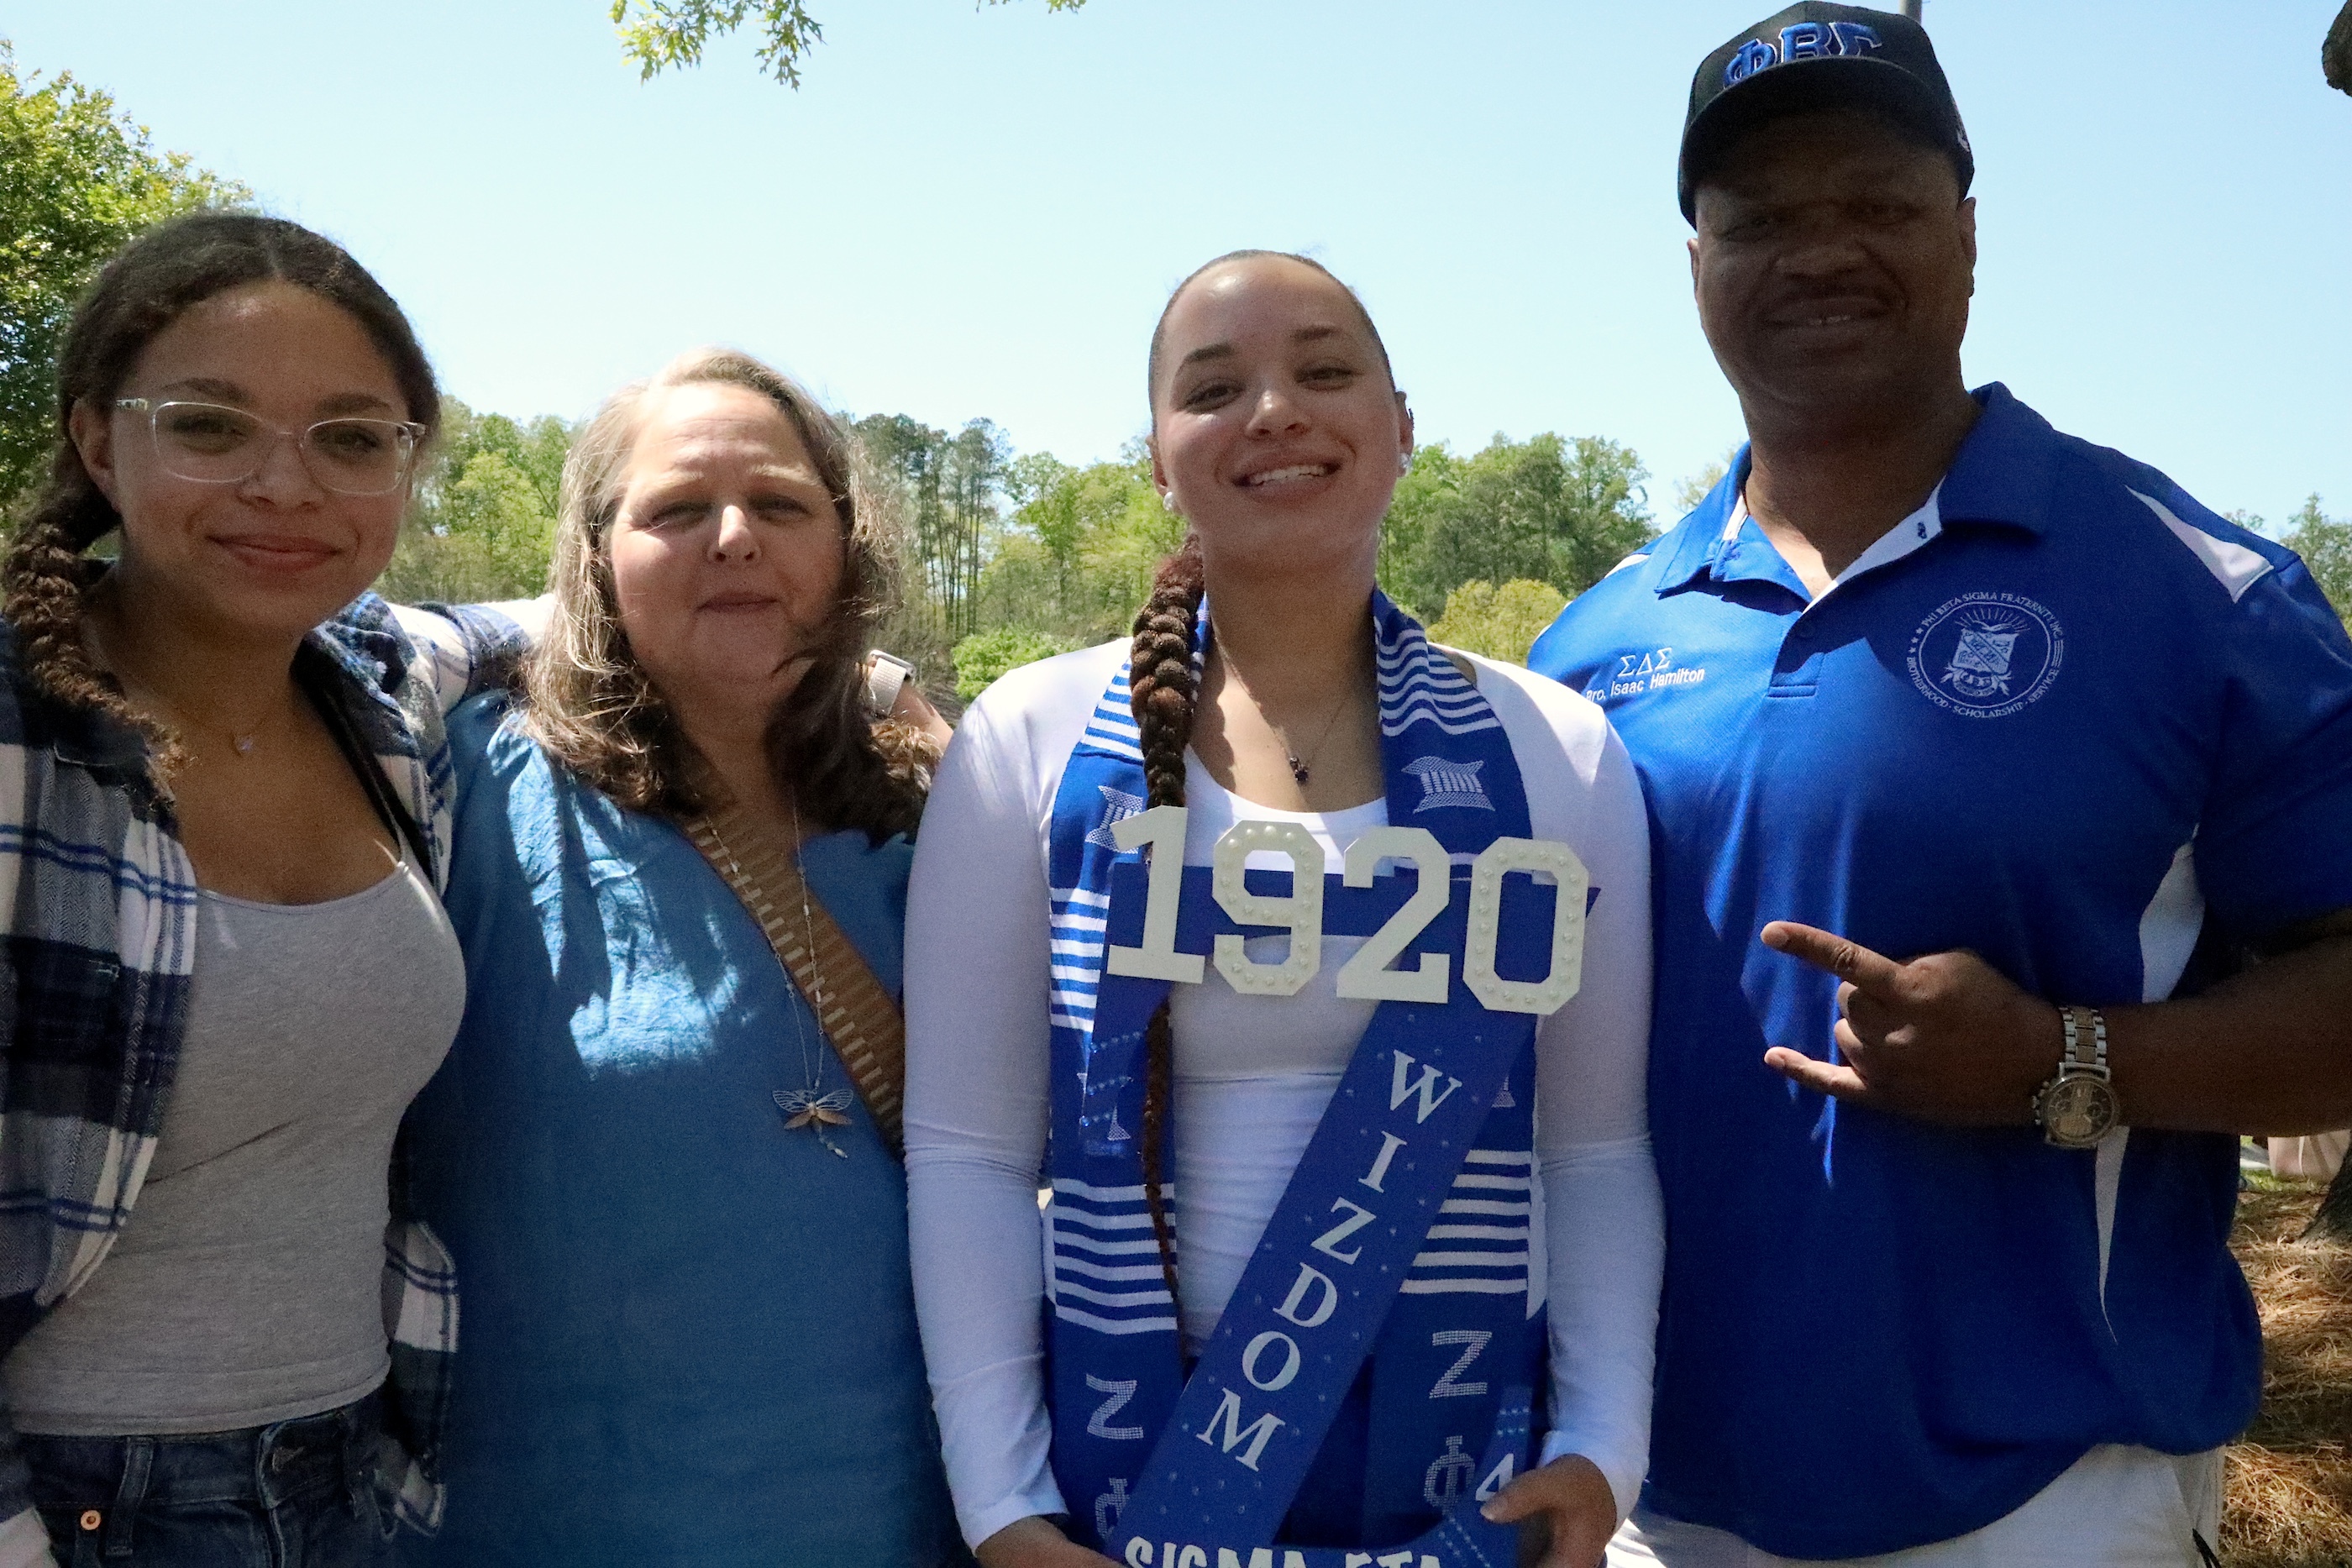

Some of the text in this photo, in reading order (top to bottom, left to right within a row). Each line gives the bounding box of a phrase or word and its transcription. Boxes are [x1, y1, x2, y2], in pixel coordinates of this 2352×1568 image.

[1921, 611, 1939, 627] PHI
[1935, 596, 1963, 616] BETA
[1961, 591, 1998, 602] SIGMA
[1610, 679, 1645, 698] Isaac
[1649, 667, 1706, 690] Hamilton
[1906, 656, 1950, 708] BROTHERHOOD
[1952, 701, 2024, 719] SCHOLARSHIP
[2027, 668, 2061, 704] SERVICE
[1106, 804, 1590, 1016] 1920
[1196, 1049, 1463, 1473] WIZDOM
